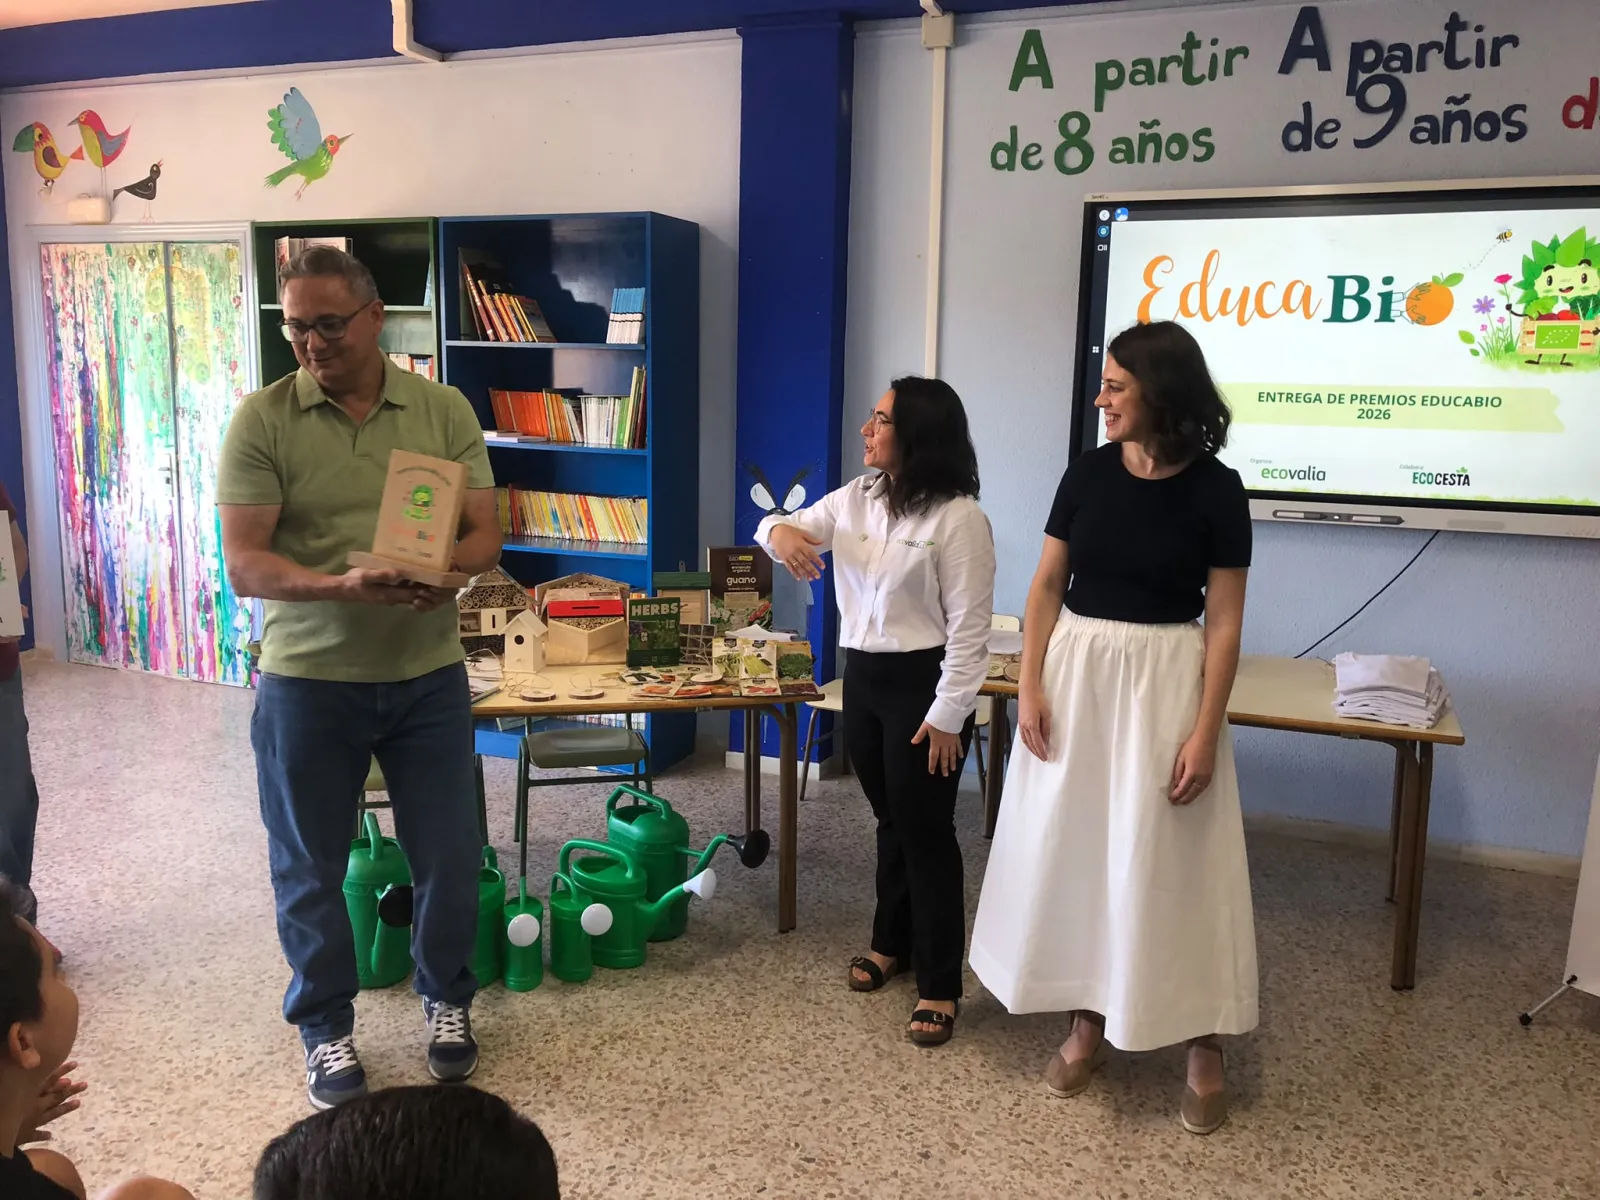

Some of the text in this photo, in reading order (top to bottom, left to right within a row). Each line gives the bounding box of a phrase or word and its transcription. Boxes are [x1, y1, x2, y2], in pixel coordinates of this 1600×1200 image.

[1278, 6, 1521, 96] A partir
[1008, 28, 1250, 112] A partir
[1561, 76, 1600, 130] d
[1281, 74, 1529, 153] de 9 años
[990, 111, 1216, 176] de 8 años
[1257, 391, 1503, 408] ENTREGA DE PREMIOS EDUCABIO
[1356, 408, 1391, 420] 2026
[1261, 465, 1326, 481] ecovalia
[1412, 472, 1471, 486] ECOCESTA
[726, 576, 756, 586] guano
[631, 602, 679, 617] HERBS
